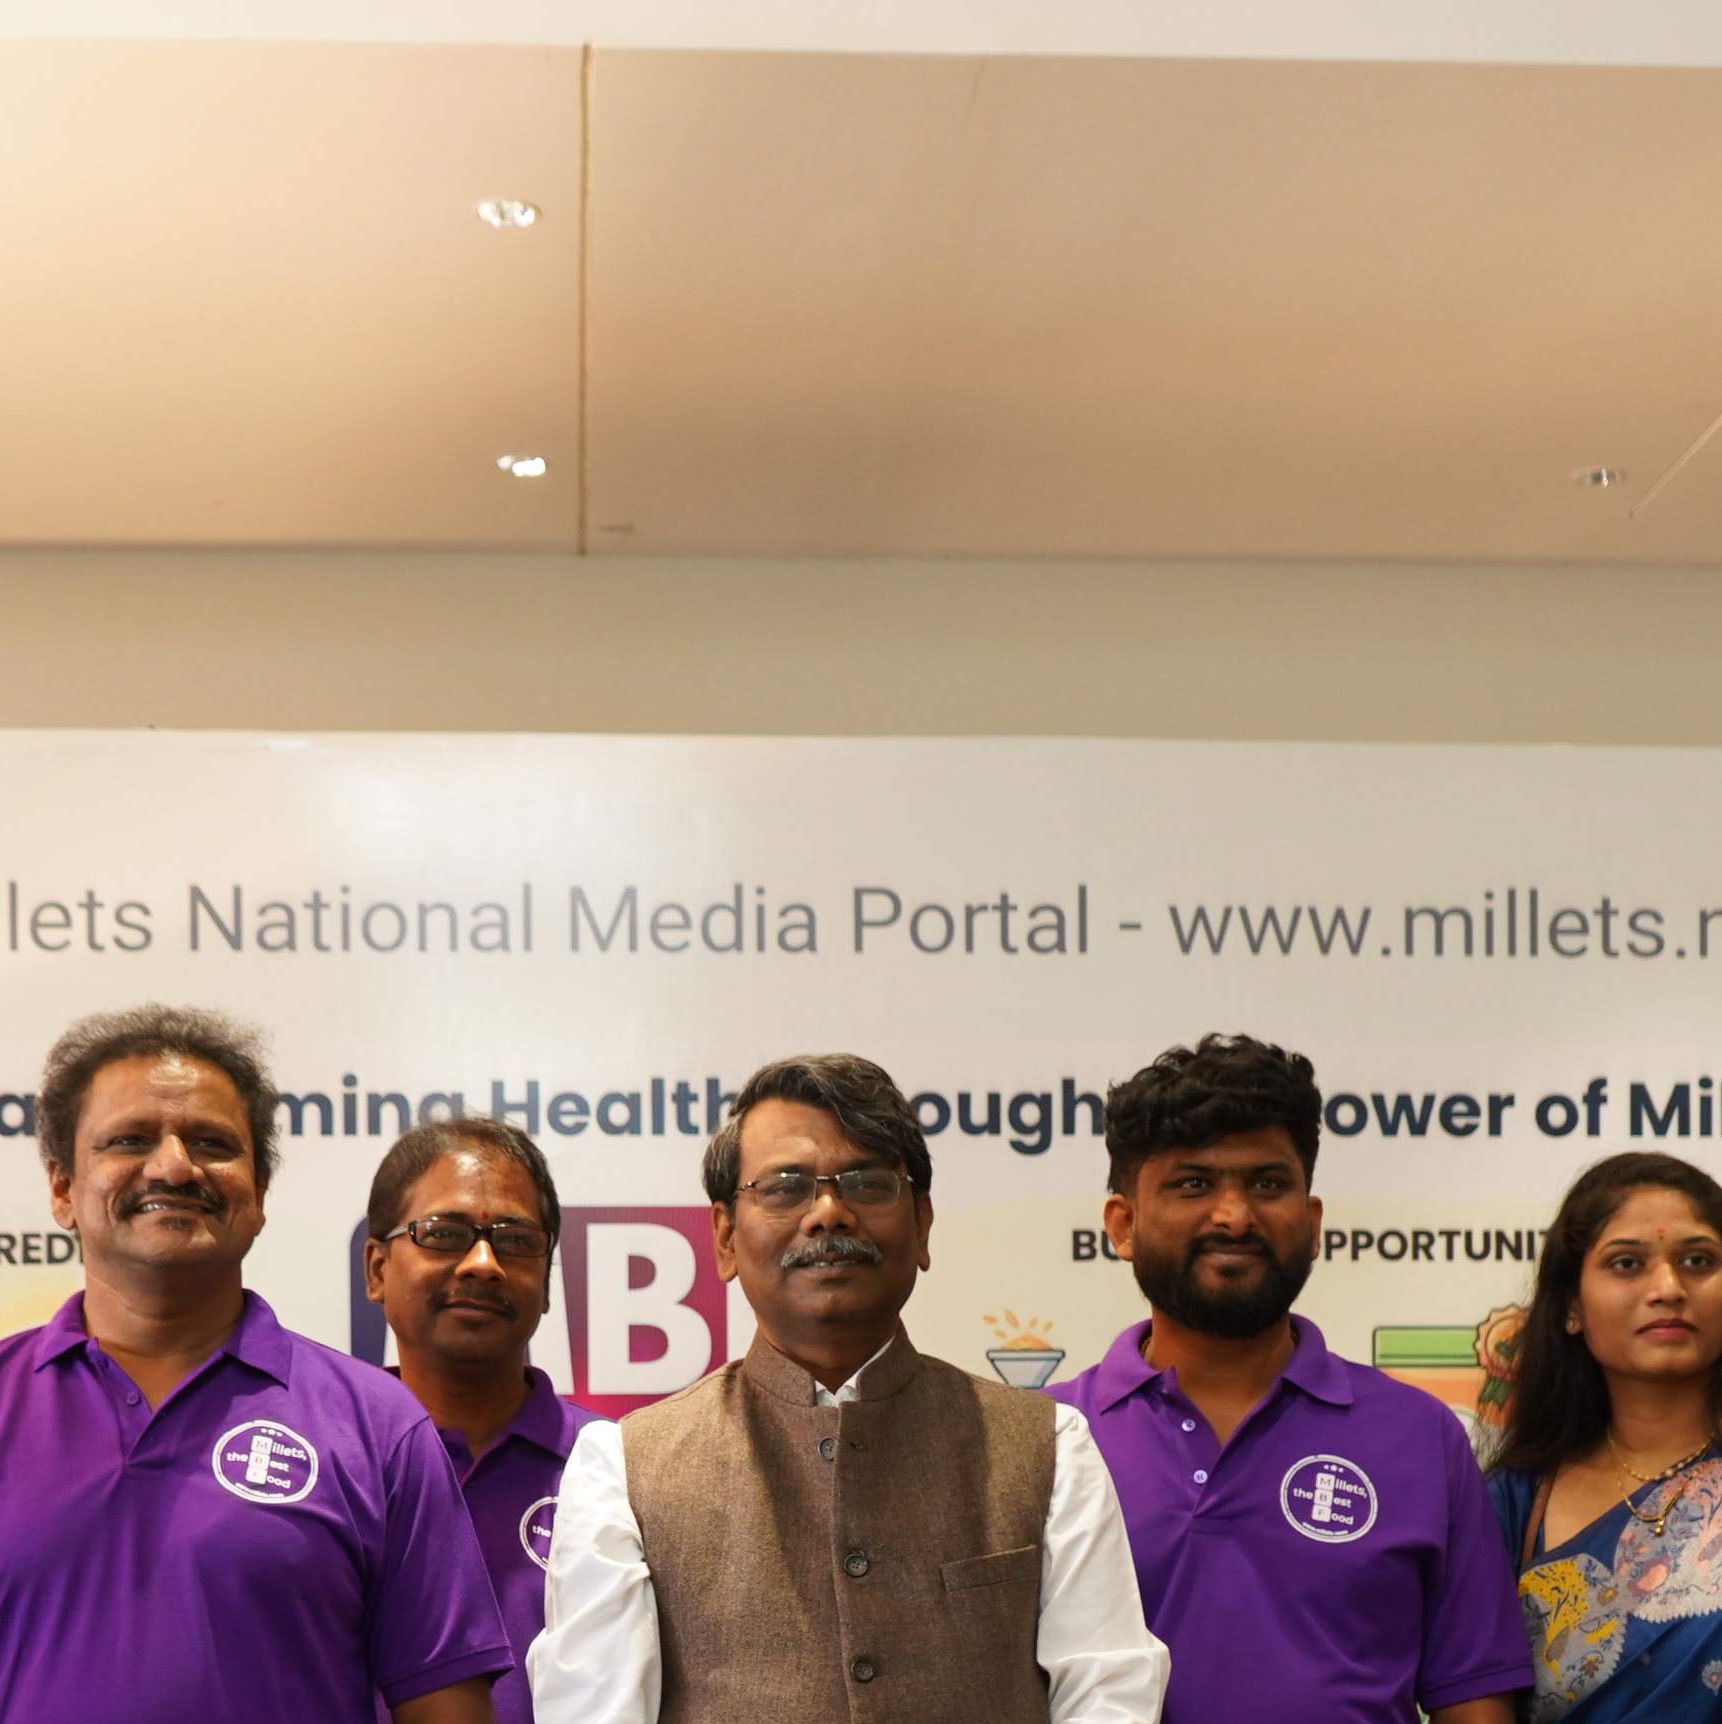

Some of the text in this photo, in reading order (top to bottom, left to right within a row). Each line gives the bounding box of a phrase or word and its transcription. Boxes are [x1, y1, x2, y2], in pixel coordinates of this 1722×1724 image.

[189, 883, 533, 954] National
[569, 882, 819, 955] Media
[853, 883, 1089, 955] Portal
[1118, 921, 1143, 931] -
[913, 1076, 1106, 1156] ough
[1322, 1092, 1517, 1139] ower
[1534, 1076, 1608, 1139] of
[226, 1451, 250, 1463] the
[1293, 1487, 1315, 1500] the
[532, 1525, 552, 1538] the
